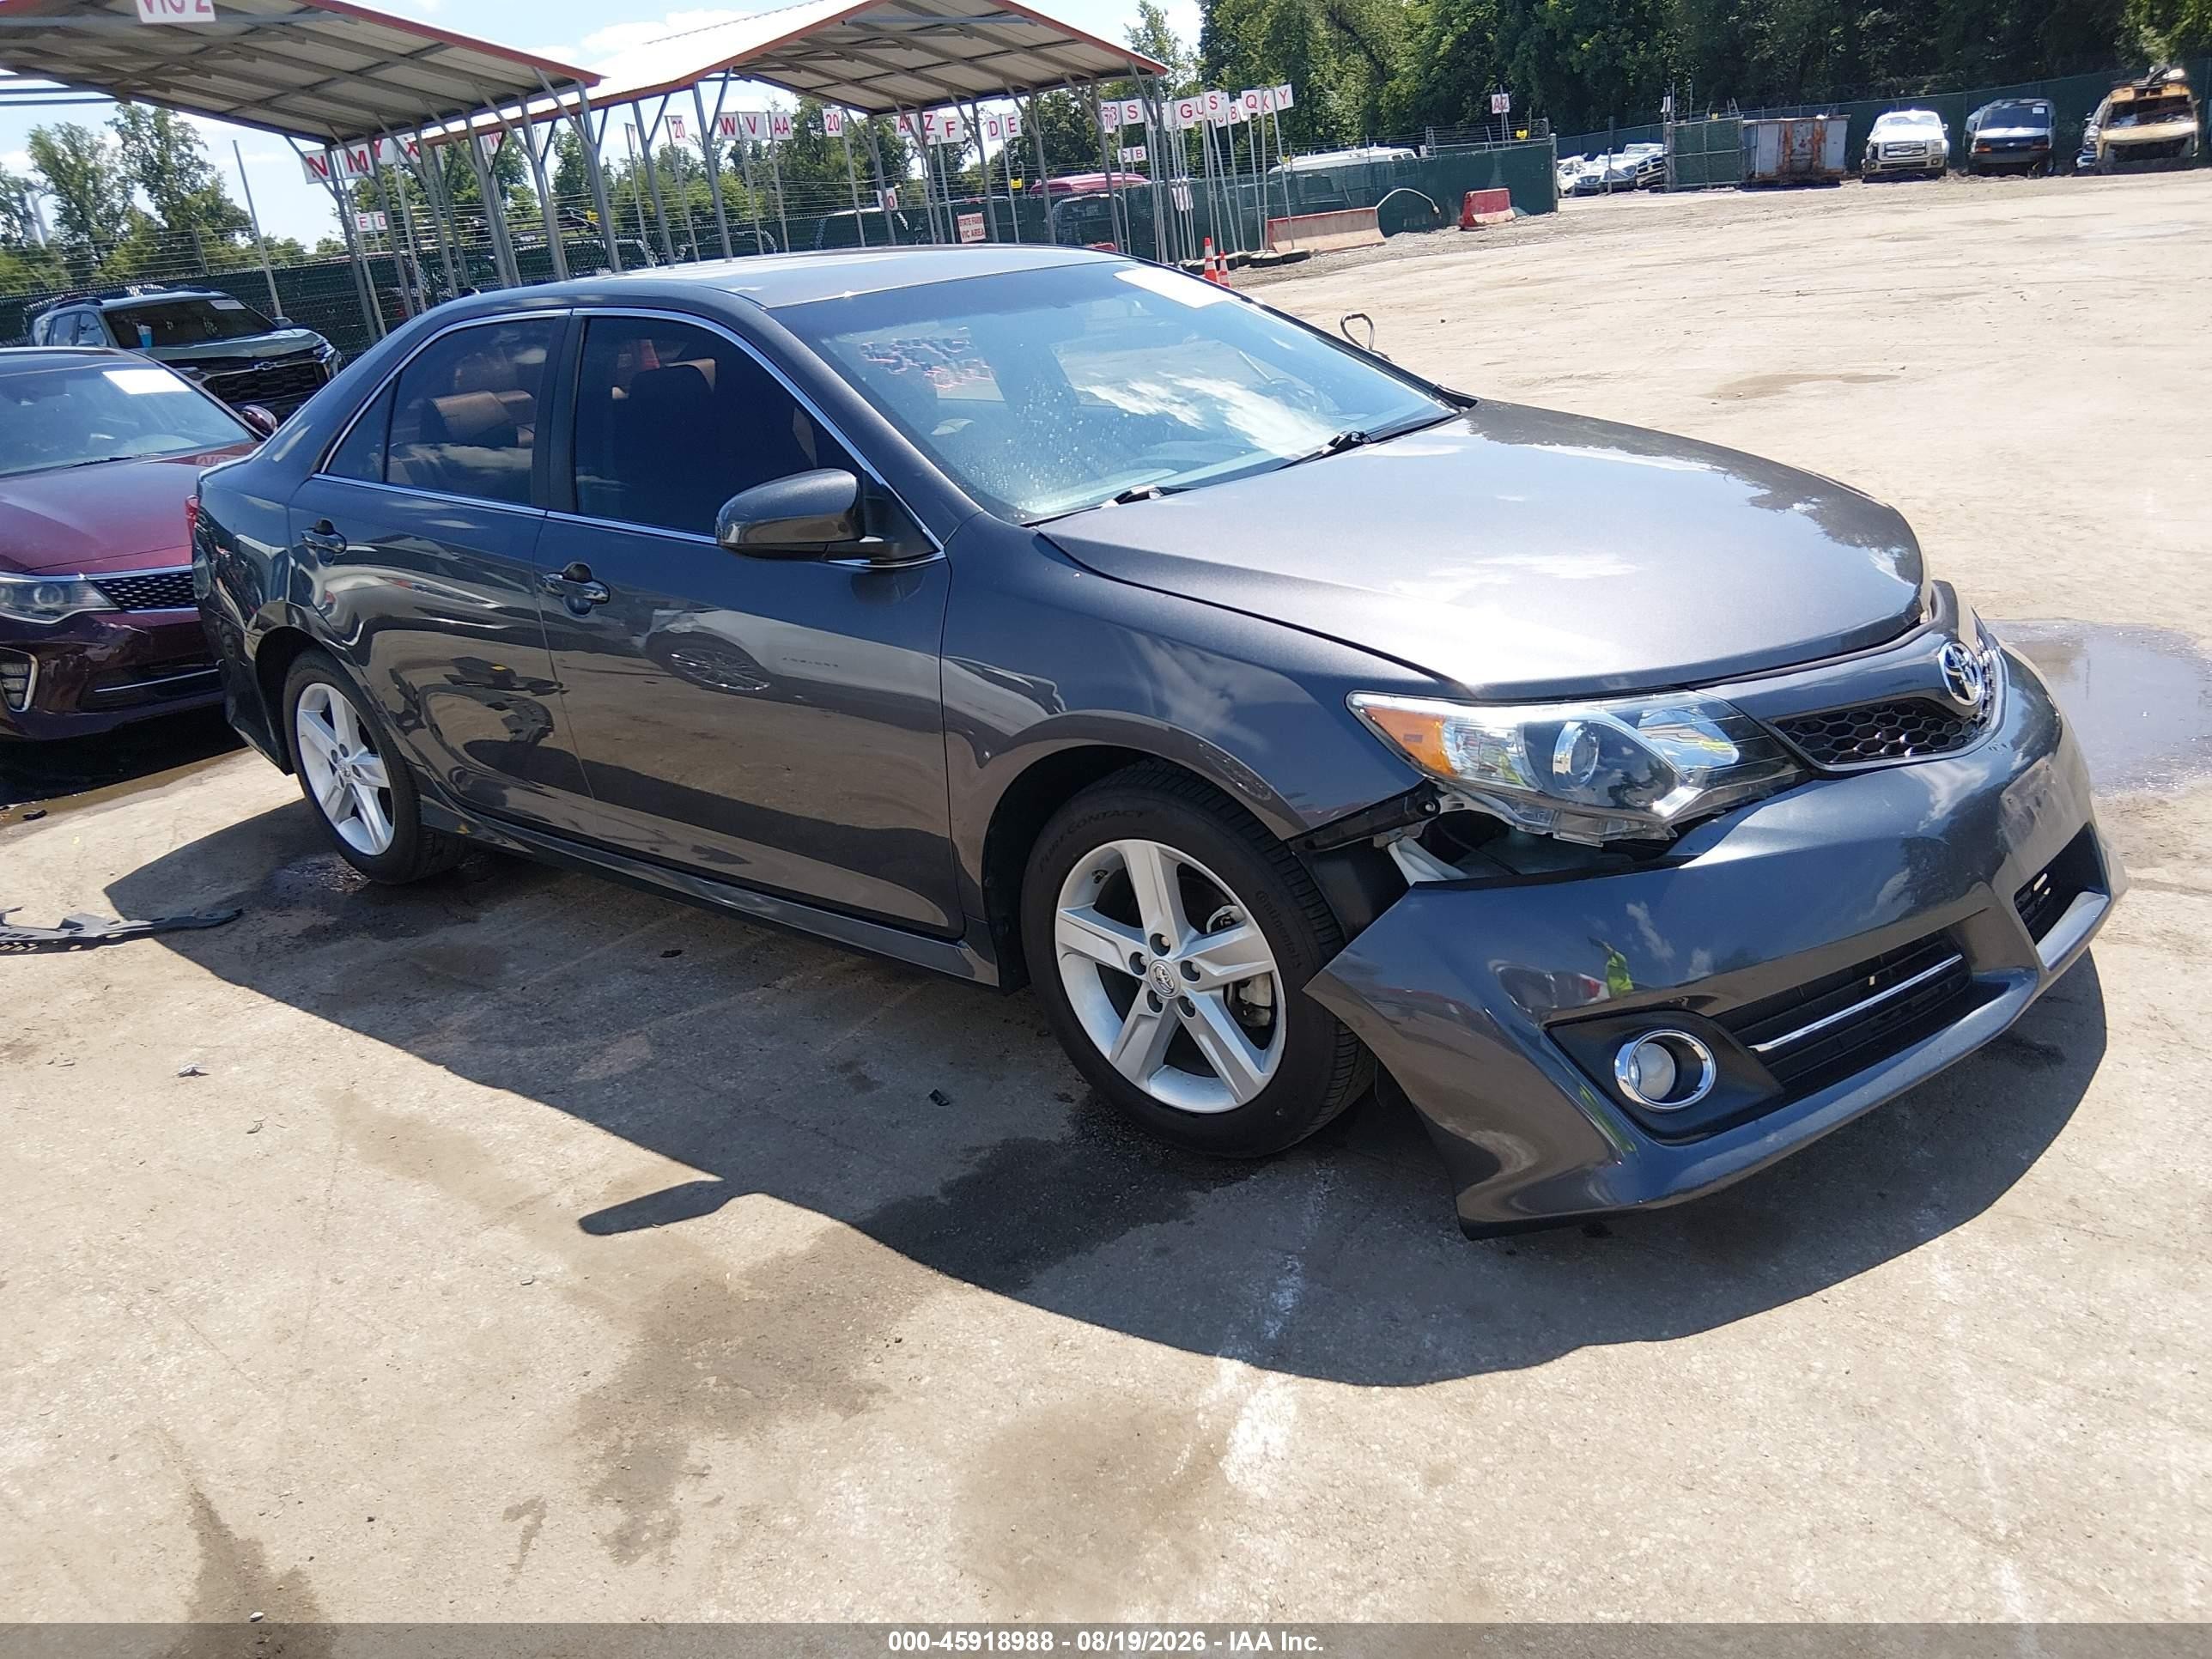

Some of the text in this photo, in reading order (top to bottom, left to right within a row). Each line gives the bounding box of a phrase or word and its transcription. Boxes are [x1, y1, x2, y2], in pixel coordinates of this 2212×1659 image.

[1209, 95, 1218, 110] S
[1245, 94, 1258, 109] Q
[1279, 89, 1288, 104] Y
[1127, 105, 1138, 119] S
[1180, 103, 1193, 118] G
[720, 117, 736, 136] W
[745, 116, 757, 135] V
[775, 117, 790, 135] AA
[826, 113, 840, 131] 20
[925, 114, 935, 131] Z
[945, 121, 955, 137] F
[989, 120, 998, 137] D
[1008, 116, 1017, 133] E
[347, 150, 369, 173] M
[1136, 149, 1143, 158] B
[307, 155, 329, 177] N
[359, 216, 368, 228] E
